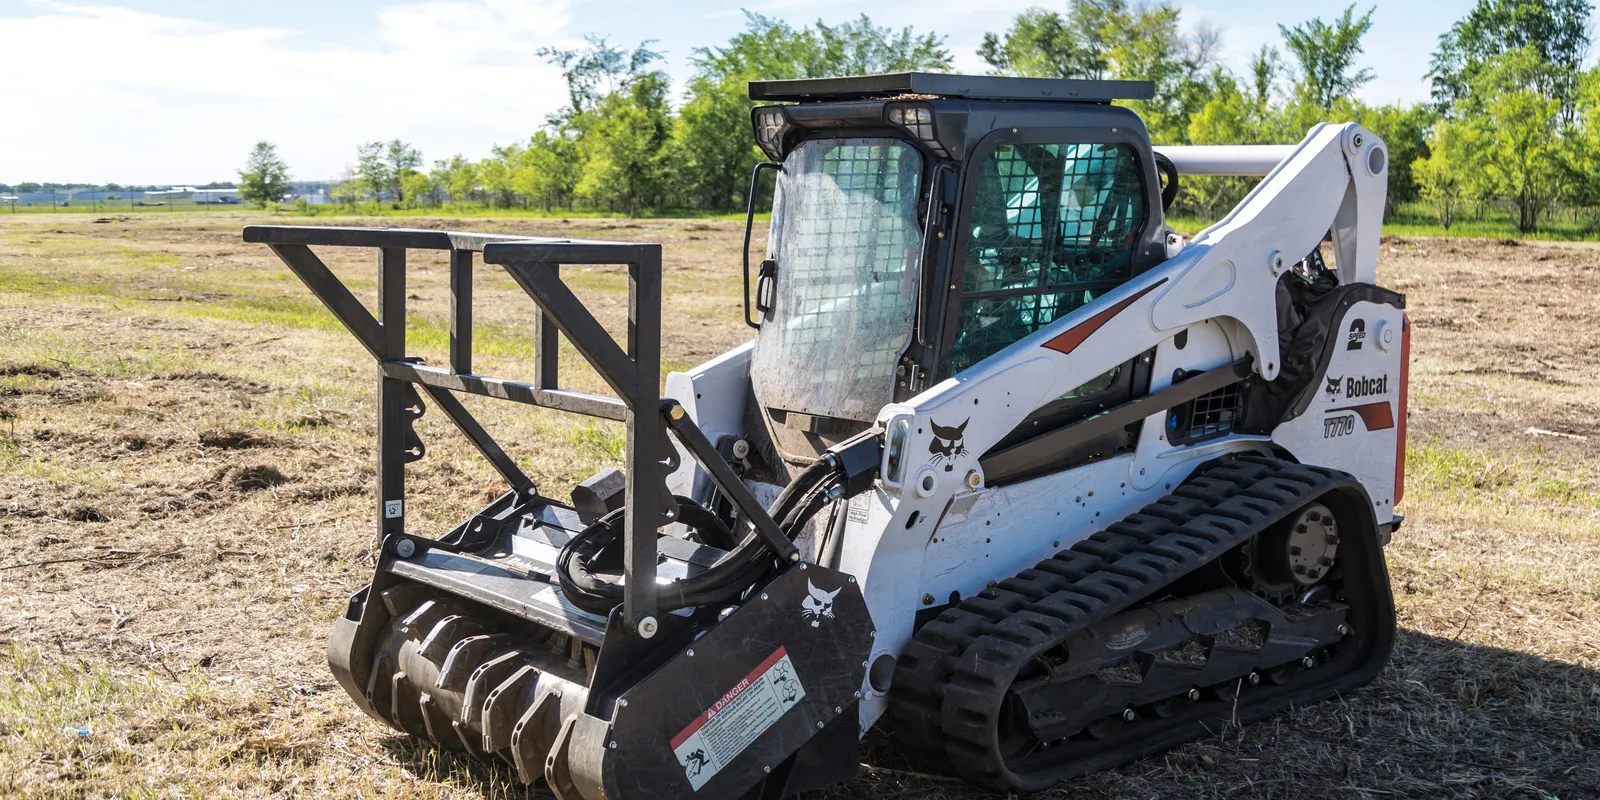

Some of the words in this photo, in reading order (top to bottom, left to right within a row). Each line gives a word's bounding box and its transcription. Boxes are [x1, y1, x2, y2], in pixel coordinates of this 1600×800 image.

[1347, 318, 1365, 351] 2
[1348, 331, 1366, 340] SPEED
[1346, 374, 1388, 398] Bobcat
[1323, 414, 1356, 439] T770
[715, 678, 750, 711] DANGER
